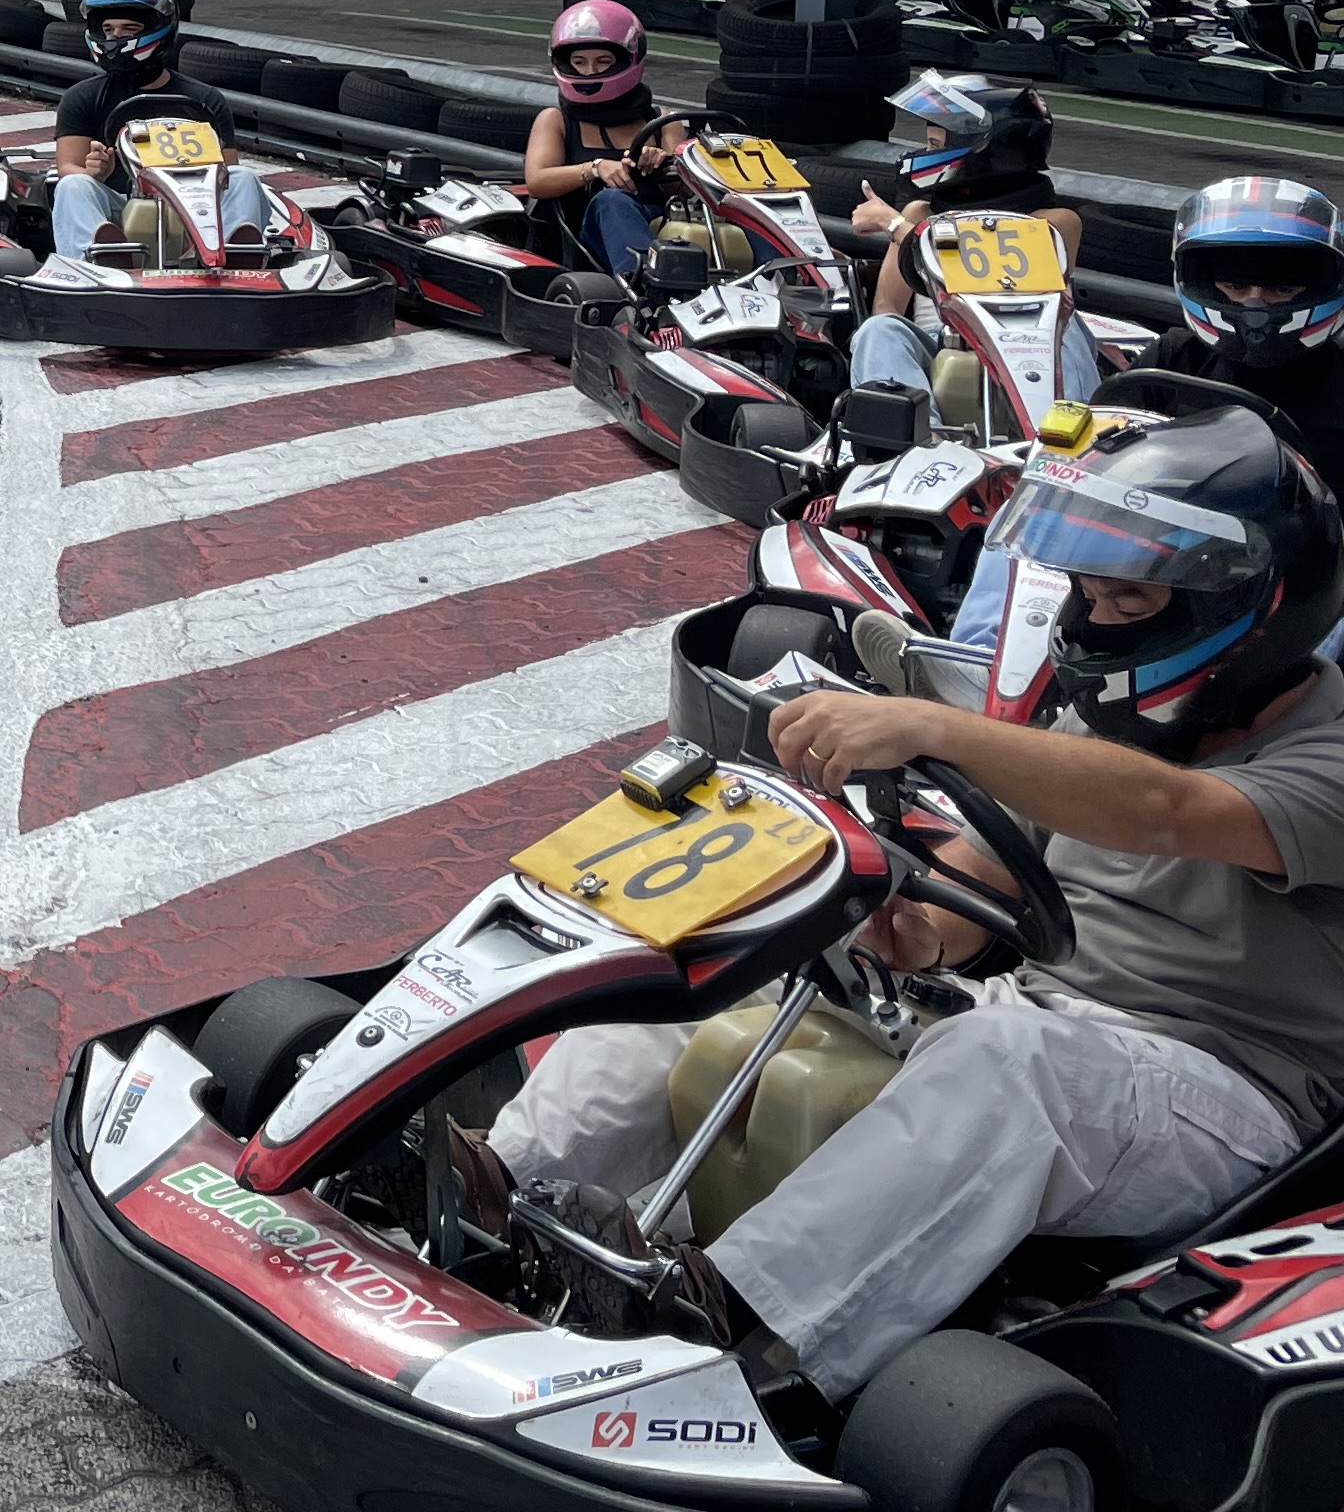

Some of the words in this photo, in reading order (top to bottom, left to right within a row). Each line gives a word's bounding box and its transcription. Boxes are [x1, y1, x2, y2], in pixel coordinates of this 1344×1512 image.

[156, 131, 203, 159] 85
[959, 229, 1029, 278] 65
[1021, 576, 1071, 593] FERBER
[765, 817, 817, 846] 18
[573, 803, 755, 900] 18
[393, 975, 458, 1017] FERBERTO
[105, 1092, 143, 1145] SWS
[161, 1162, 460, 1330] EUROINDY
[552, 1358, 643, 1389] SWS
[645, 1418, 758, 1443] SODI
